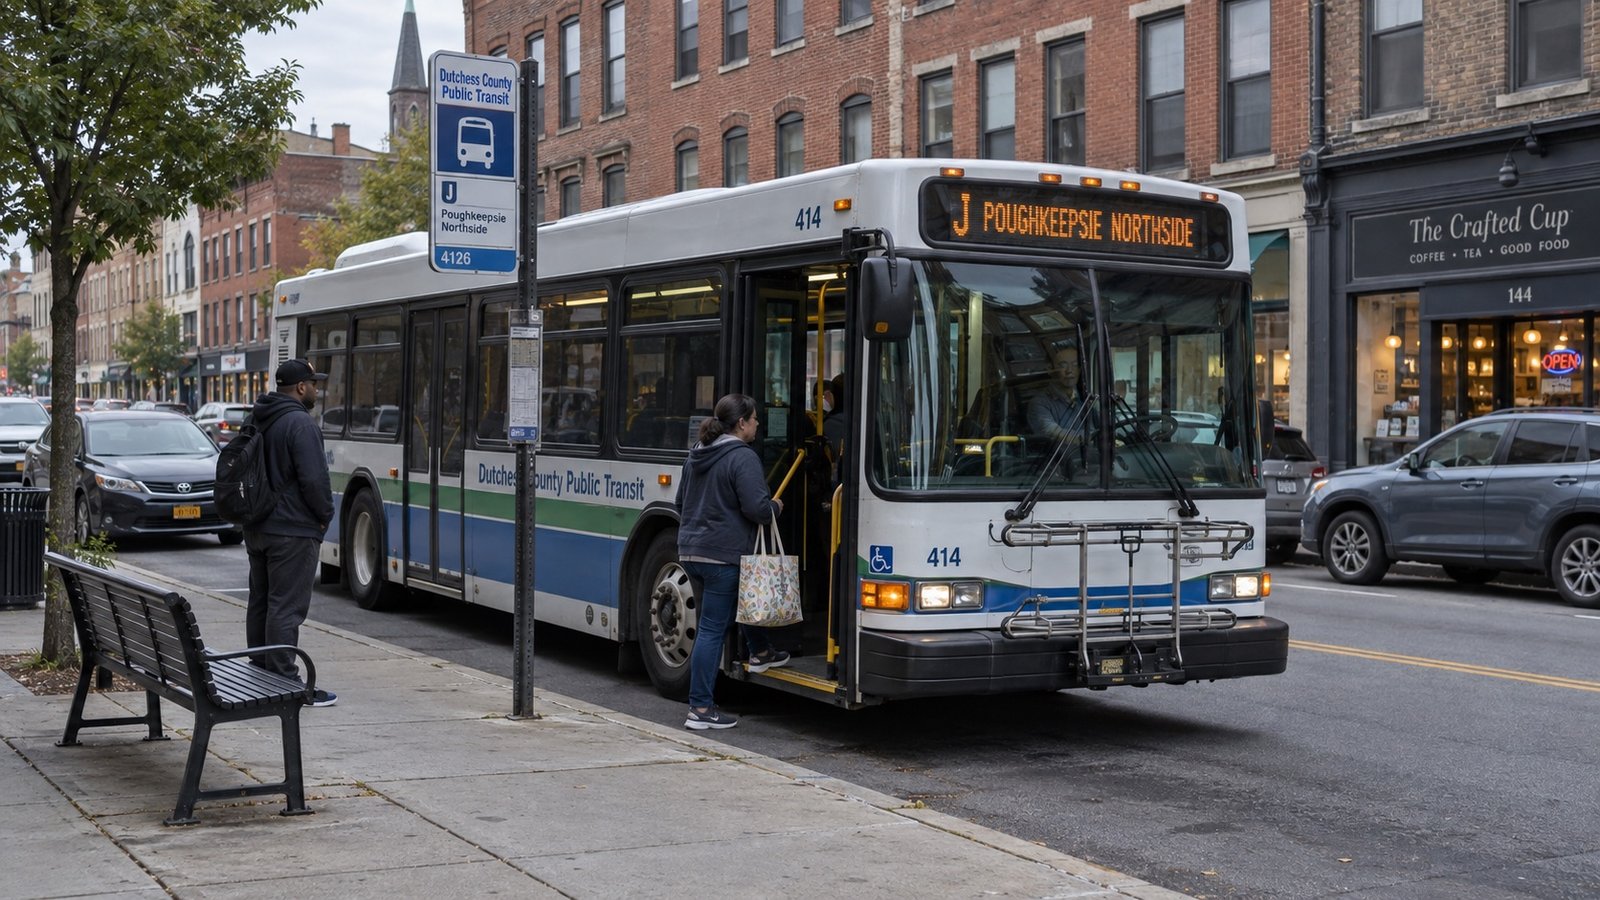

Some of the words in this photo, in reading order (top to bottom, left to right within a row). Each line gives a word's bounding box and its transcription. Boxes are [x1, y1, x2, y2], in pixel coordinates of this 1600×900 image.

[440, 67, 480, 86] Dutchess
[482, 72, 512, 92] County
[442, 85, 473, 101] Public
[476, 88, 509, 105] Transit
[445, 183, 453, 201] J
[441, 208, 507, 223] Poughkeepsie
[795, 205, 821, 231] 414
[953, 193, 971, 237] J
[983, 201, 1103, 241] POUGHKEEPSIE
[1111, 212, 1194, 248] NORTHSIDE
[1409, 216, 1443, 244] The
[1450, 205, 1522, 243] Crafted
[1530, 203, 1569, 235] Cup
[441, 221, 488, 234] Northside
[440, 250, 471, 265] 4126
[1409, 251, 1446, 264] COFFEE
[1463, 248, 1482, 259] TEA
[1500, 242, 1532, 255] GOOD
[1538, 238, 1570, 251] FOOD
[1508, 286, 1533, 303] 144
[1542, 353, 1578, 369] OPEN
[478, 463, 518, 487] Dutches
[534, 470, 563, 497] ounty
[566, 470, 601, 496] Public
[604, 474, 645, 501] Transit
[927, 547, 962, 567] 414
